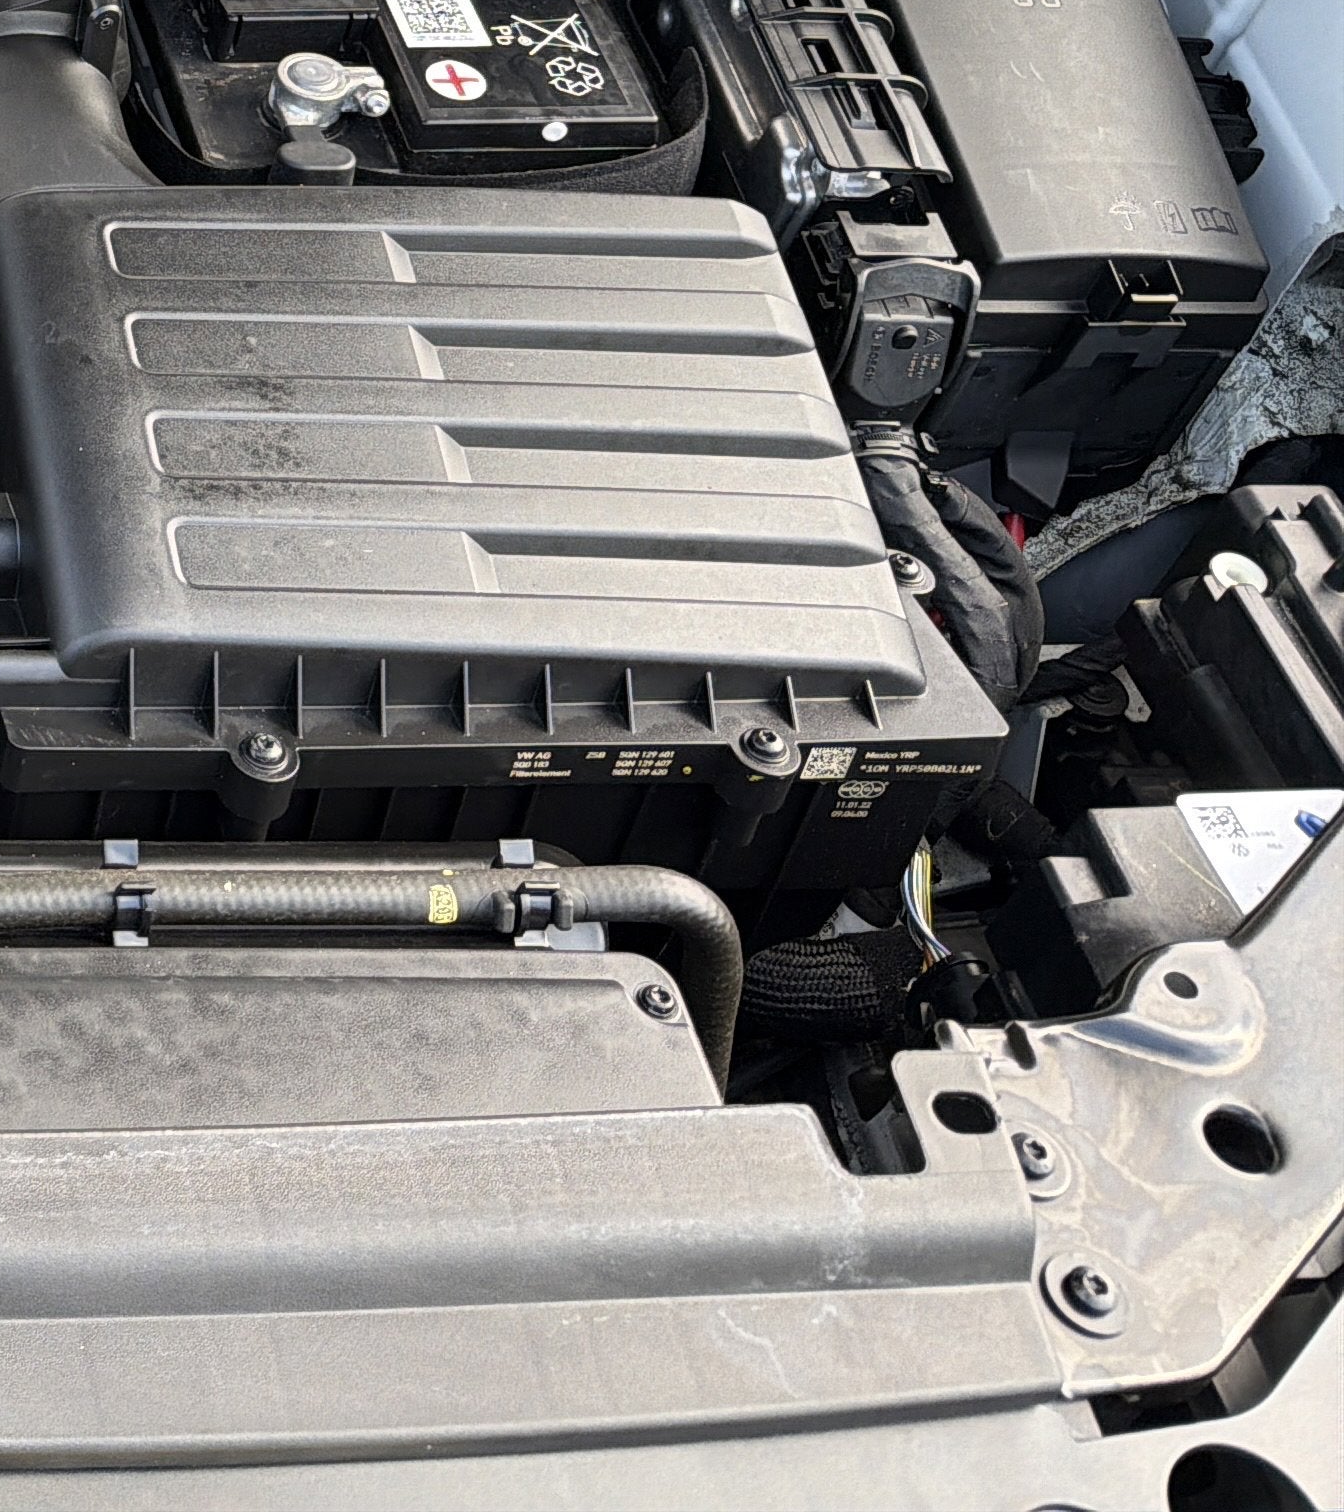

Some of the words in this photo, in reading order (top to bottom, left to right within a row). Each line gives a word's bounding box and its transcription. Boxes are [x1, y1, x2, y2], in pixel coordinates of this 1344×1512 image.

[490, 25, 514, 46] Pb
[516, 751, 534, 760] VW
[535, 751, 552, 760] AG
[865, 752, 898, 760] Mexico
[899, 751, 921, 760] YRP
